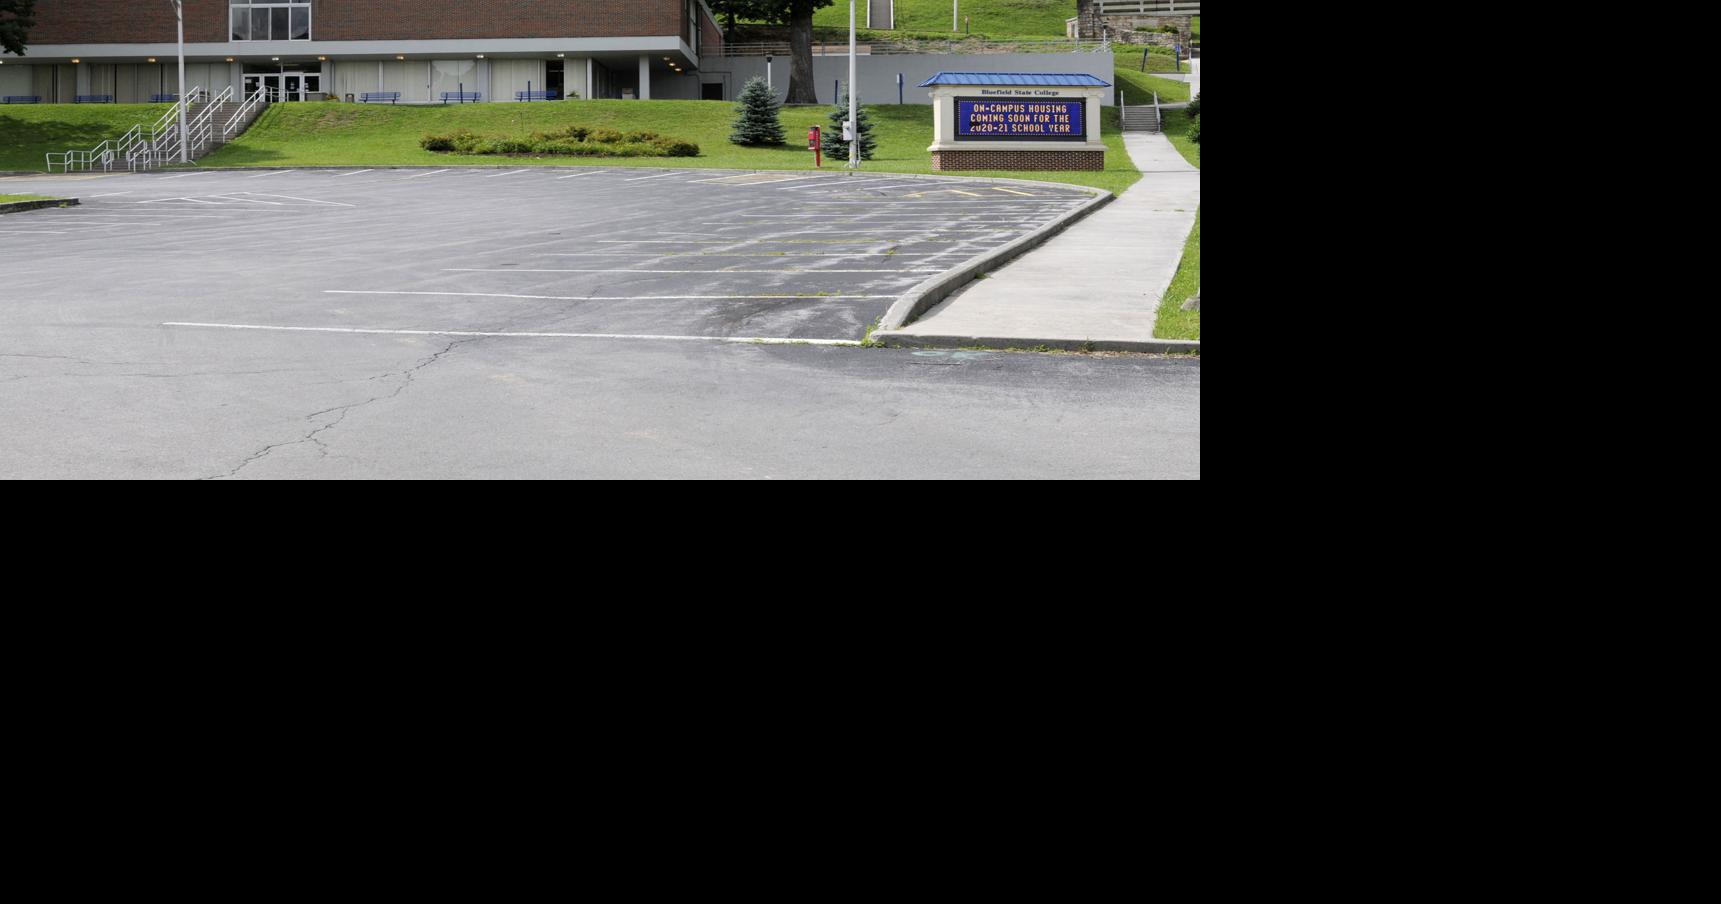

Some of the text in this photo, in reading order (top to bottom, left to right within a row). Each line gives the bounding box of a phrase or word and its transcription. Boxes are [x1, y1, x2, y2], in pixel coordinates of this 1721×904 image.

[973, 104, 1067, 113] ON-CAMPUS HOUSING
[970, 114, 1069, 123] COMING SOON FOR THE
[1011, 124, 1045, 133] SCHOOL
[1048, 124, 1071, 133] YEAR
